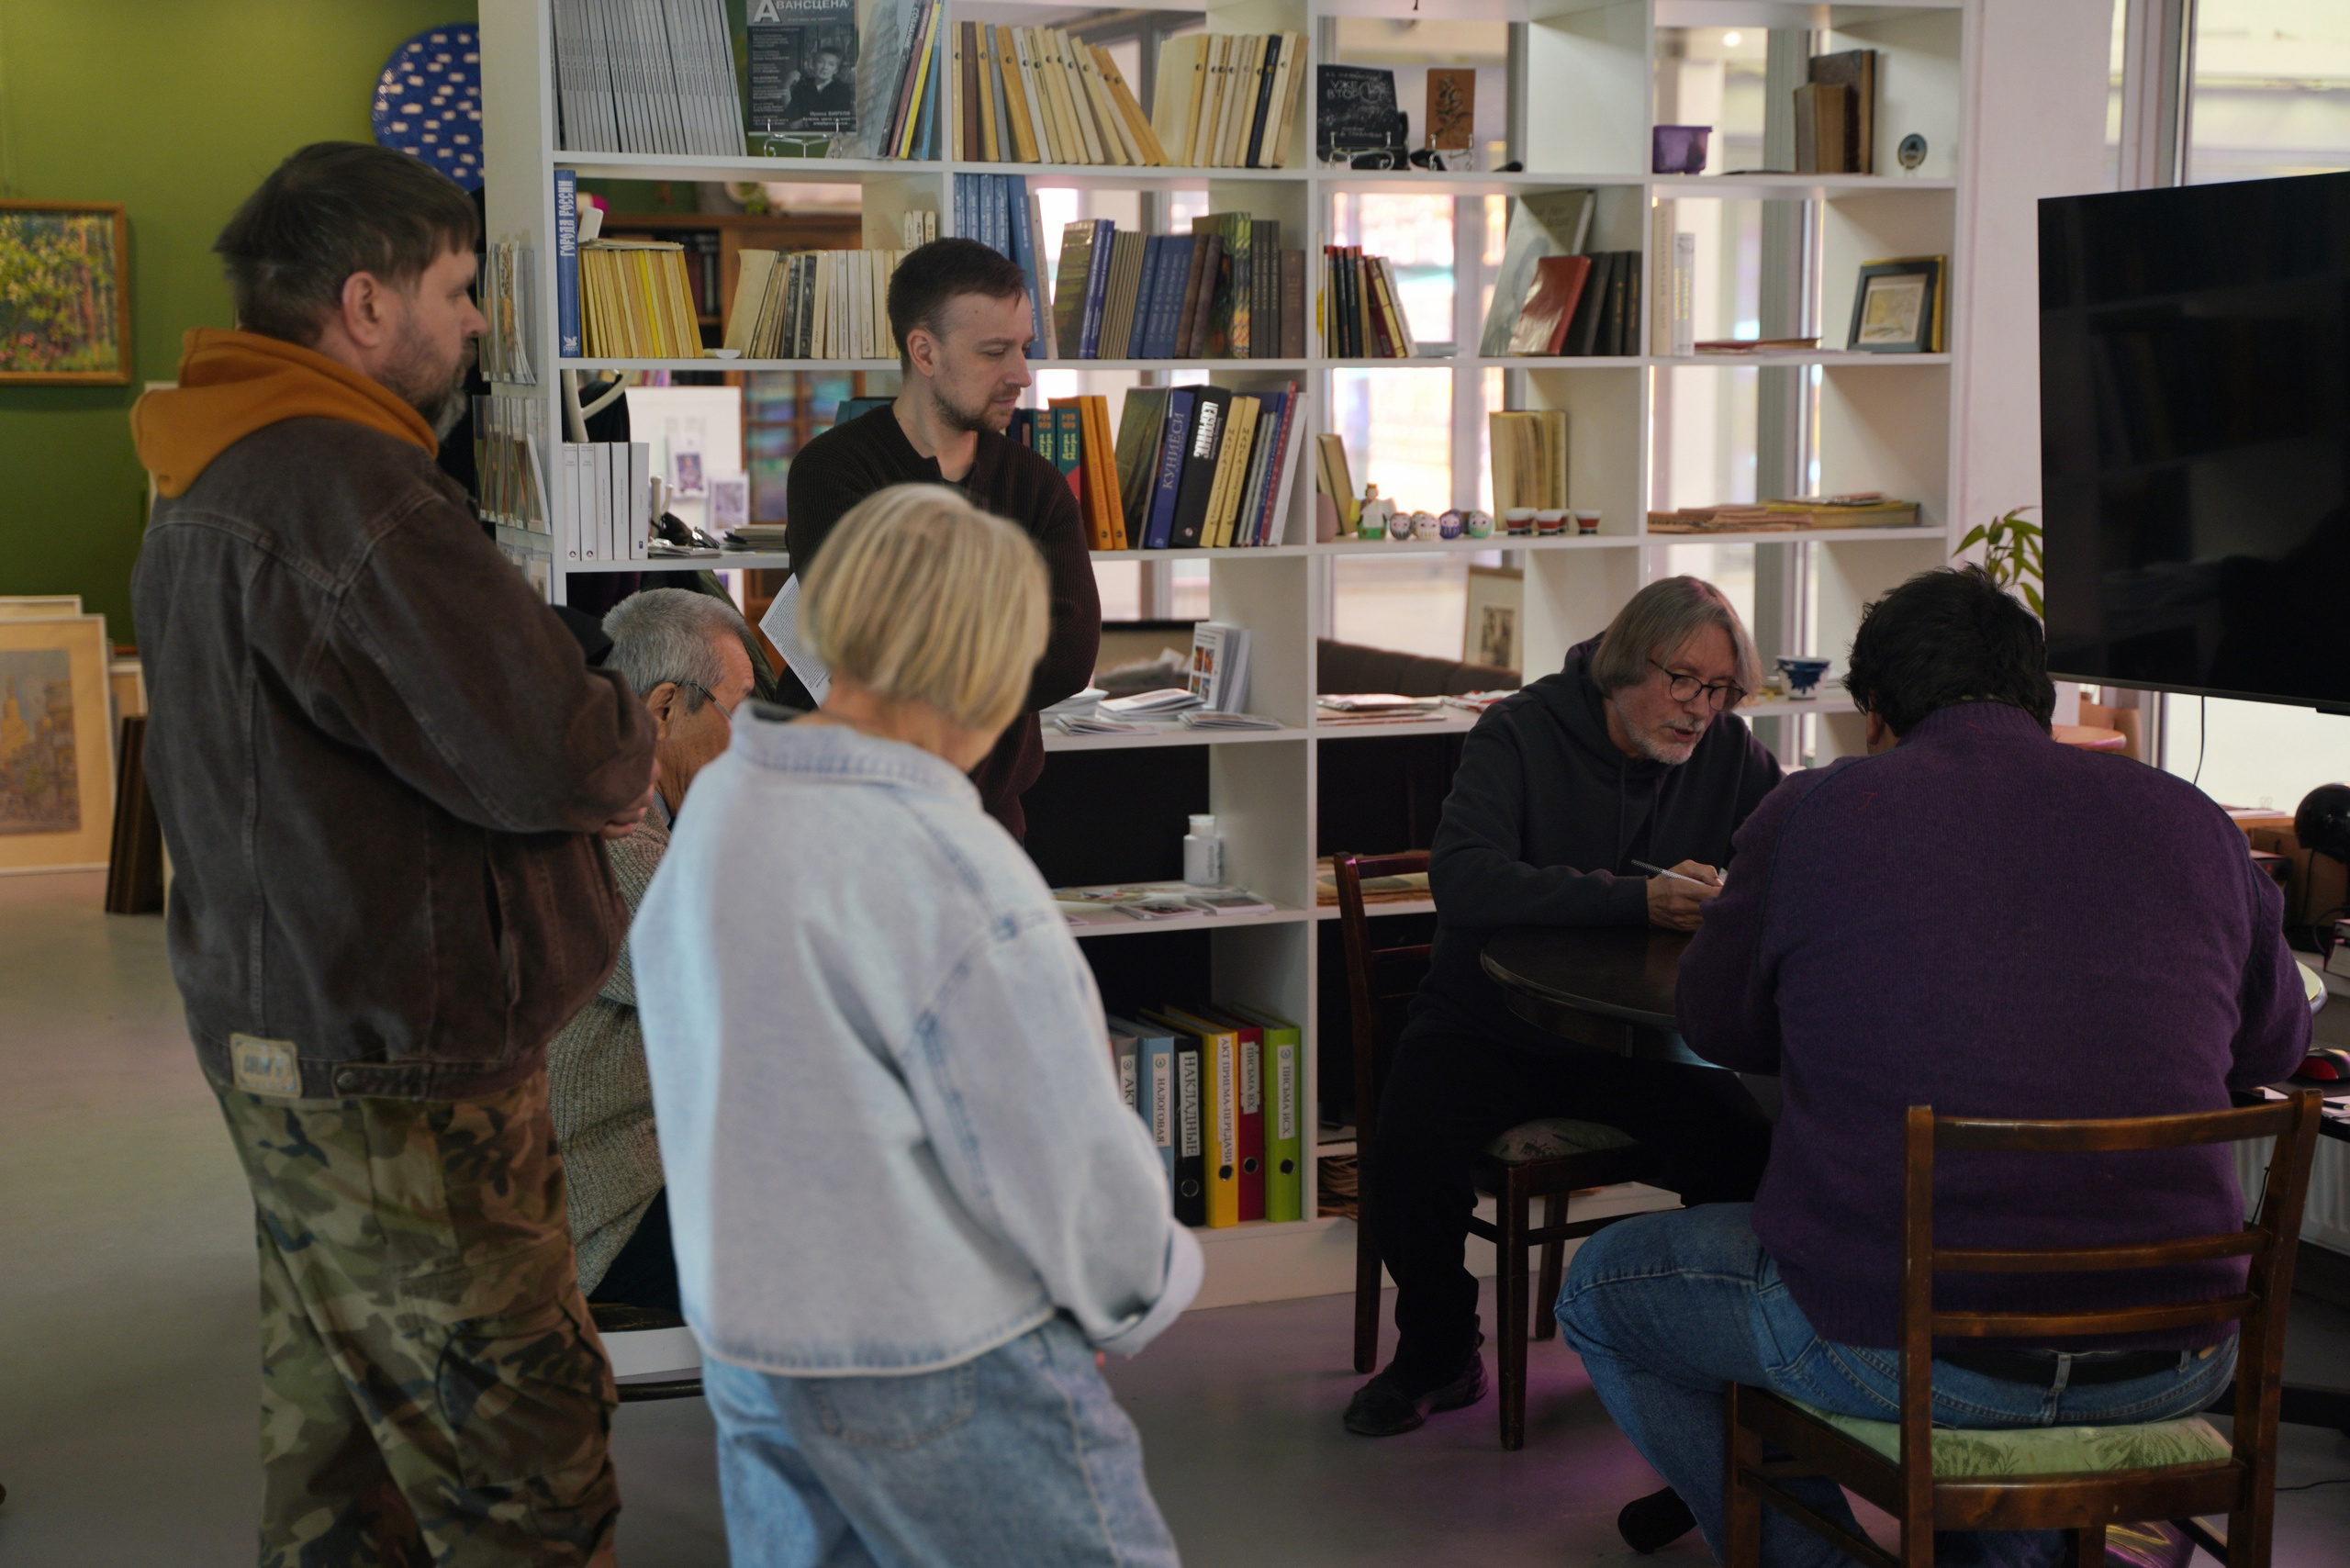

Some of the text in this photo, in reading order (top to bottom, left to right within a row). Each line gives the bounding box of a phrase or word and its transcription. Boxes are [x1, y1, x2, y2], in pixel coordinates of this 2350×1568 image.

[753, 0, 849, 24] АВАНСЦЕНА
[559, 180, 575, 256] ГОРОДА РОССИИ
[1162, 412, 1185, 489] КУНИЁСИ
[1192, 400, 1218, 459] ИЗБРАННОЕ
[1219, 427, 1236, 465] МАНГА
[1235, 426, 1250, 465] МАНГА
[1247, 1047, 1256, 1092] ПИСЬМА
[1282, 1066, 1292, 1110] ПИСЬМА
[1157, 1078, 1166, 1143] НАЛОГОВАЯ
[1184, 1056, 1198, 1155] НАКЛАДНЫЕ
[1221, 1038, 1232, 1163] АКТ ПРИЕМА-ПЕРЕДАЧИ
